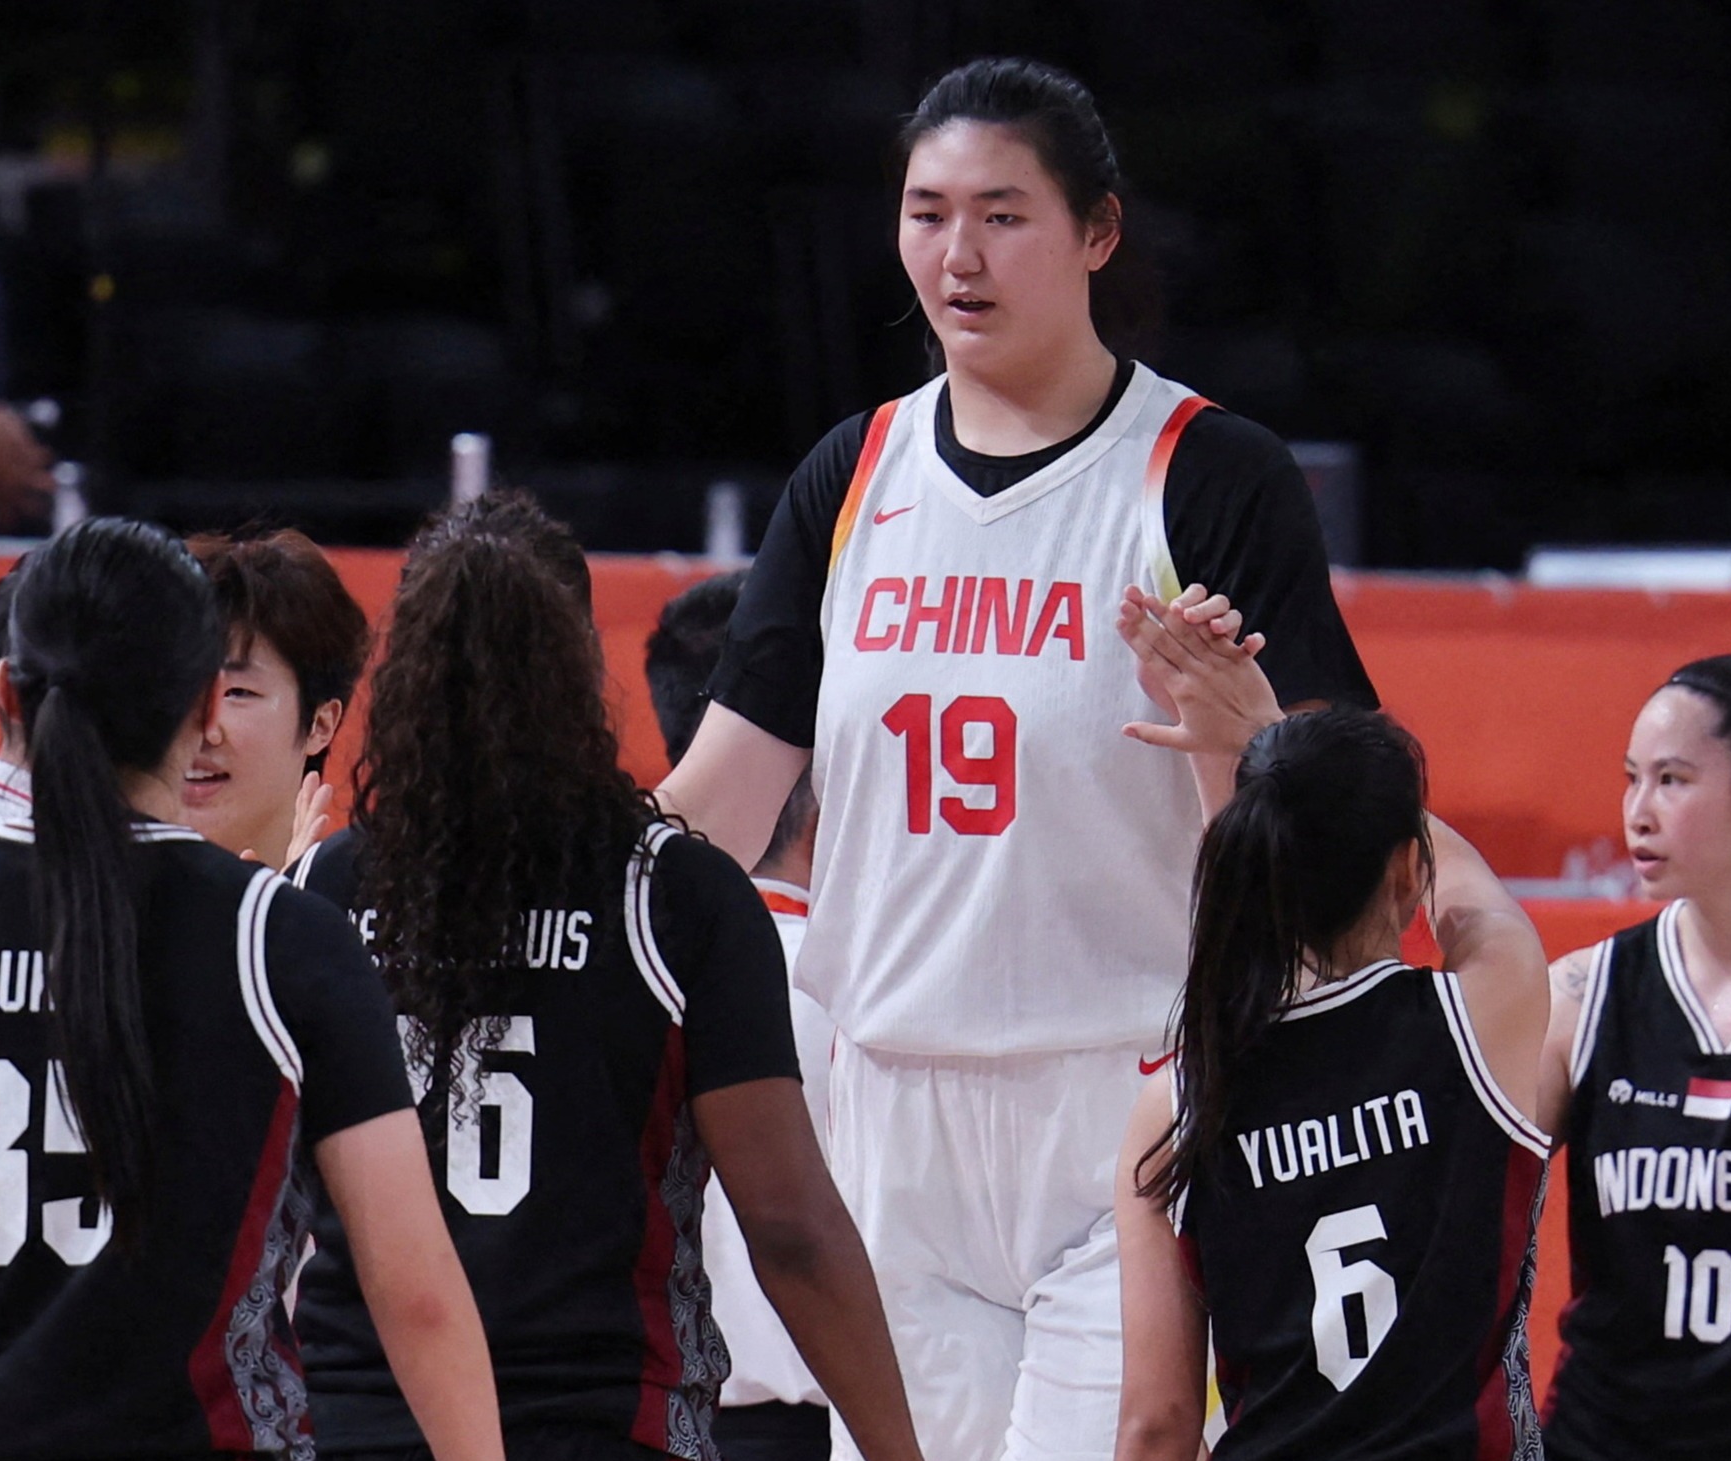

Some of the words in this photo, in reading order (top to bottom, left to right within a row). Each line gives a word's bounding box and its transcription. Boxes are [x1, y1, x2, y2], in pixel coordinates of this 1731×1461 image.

[853, 575, 1086, 661] CHINA
[881, 693, 1017, 837] 19
[1237, 1089, 1430, 1189] YUALITA
[1304, 1203, 1398, 1393] 6
